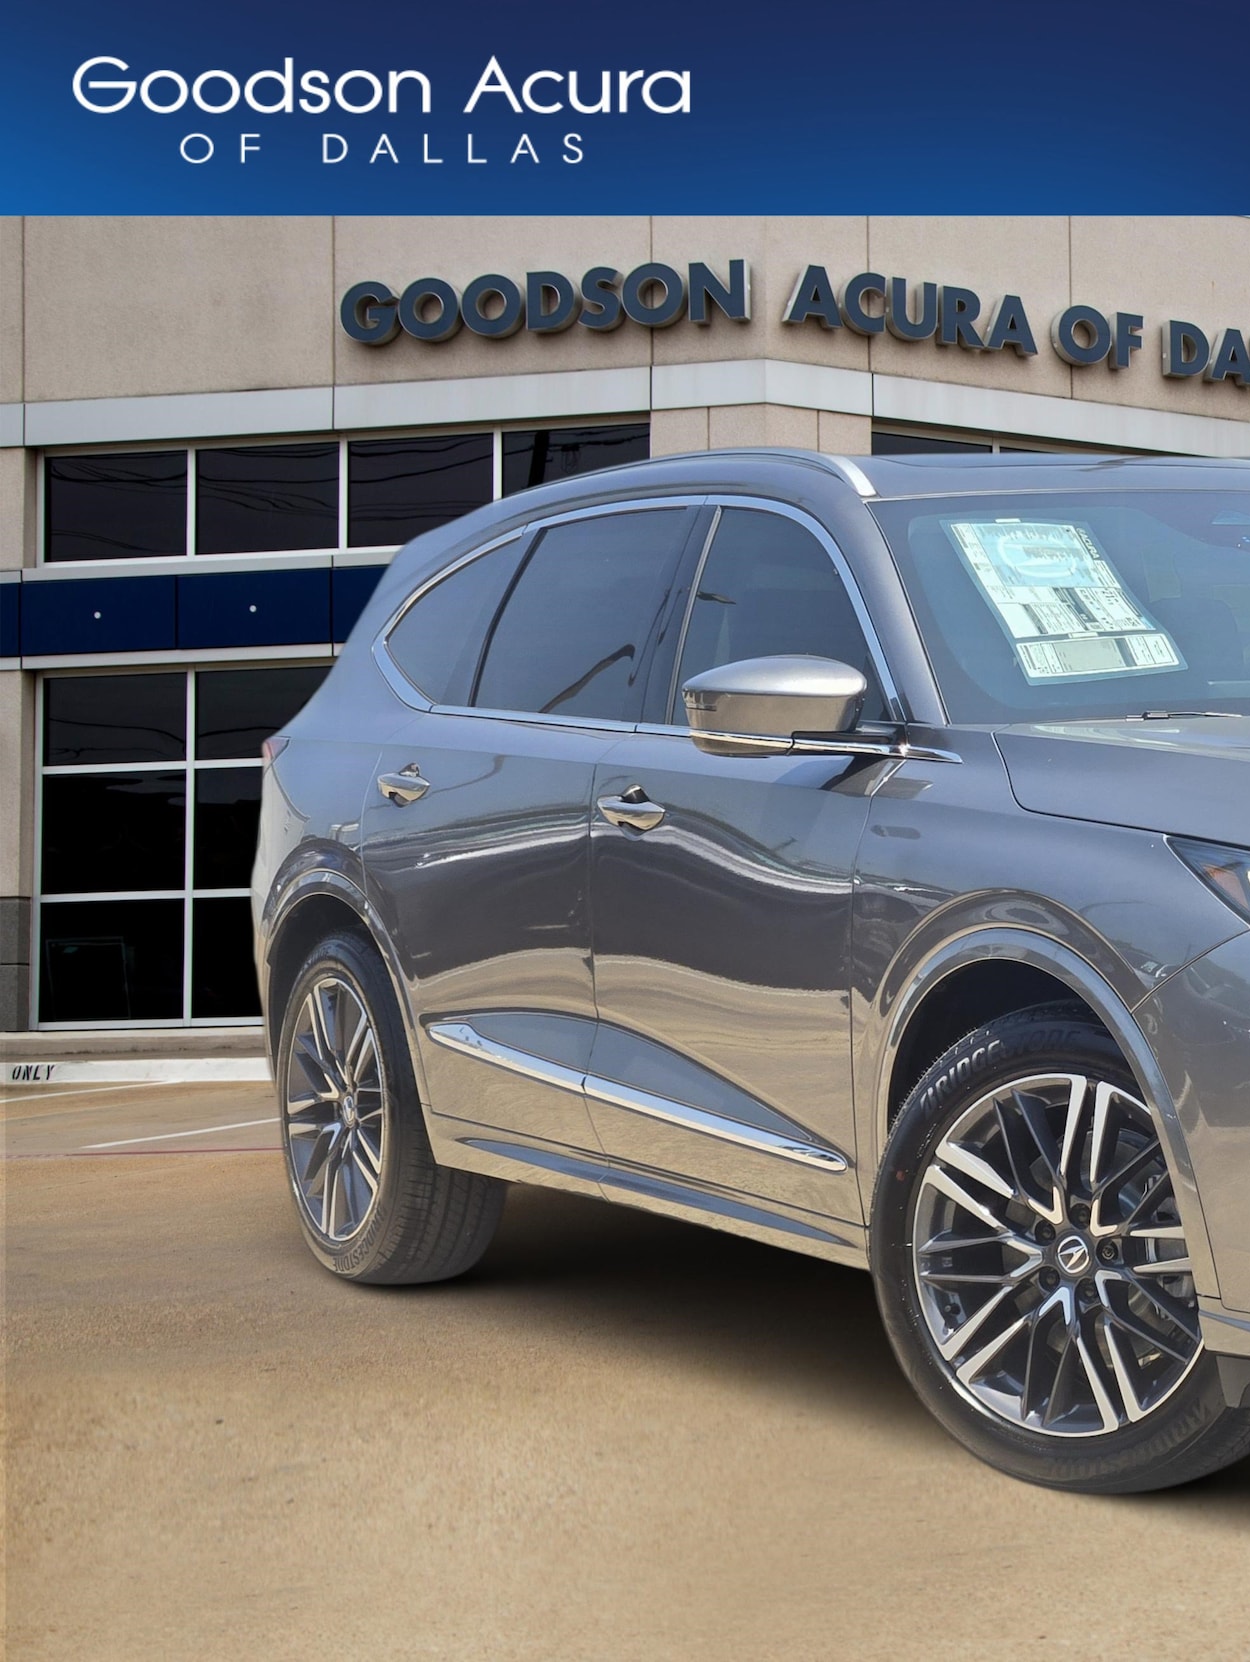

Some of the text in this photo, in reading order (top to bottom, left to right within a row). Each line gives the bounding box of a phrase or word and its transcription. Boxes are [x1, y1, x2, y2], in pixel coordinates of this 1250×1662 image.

[340, 258, 752, 346] GOODSON
[783, 264, 1038, 357] ACURA
[1051, 304, 1144, 369] OF
[12, 1064, 56, 1081] ONLY
